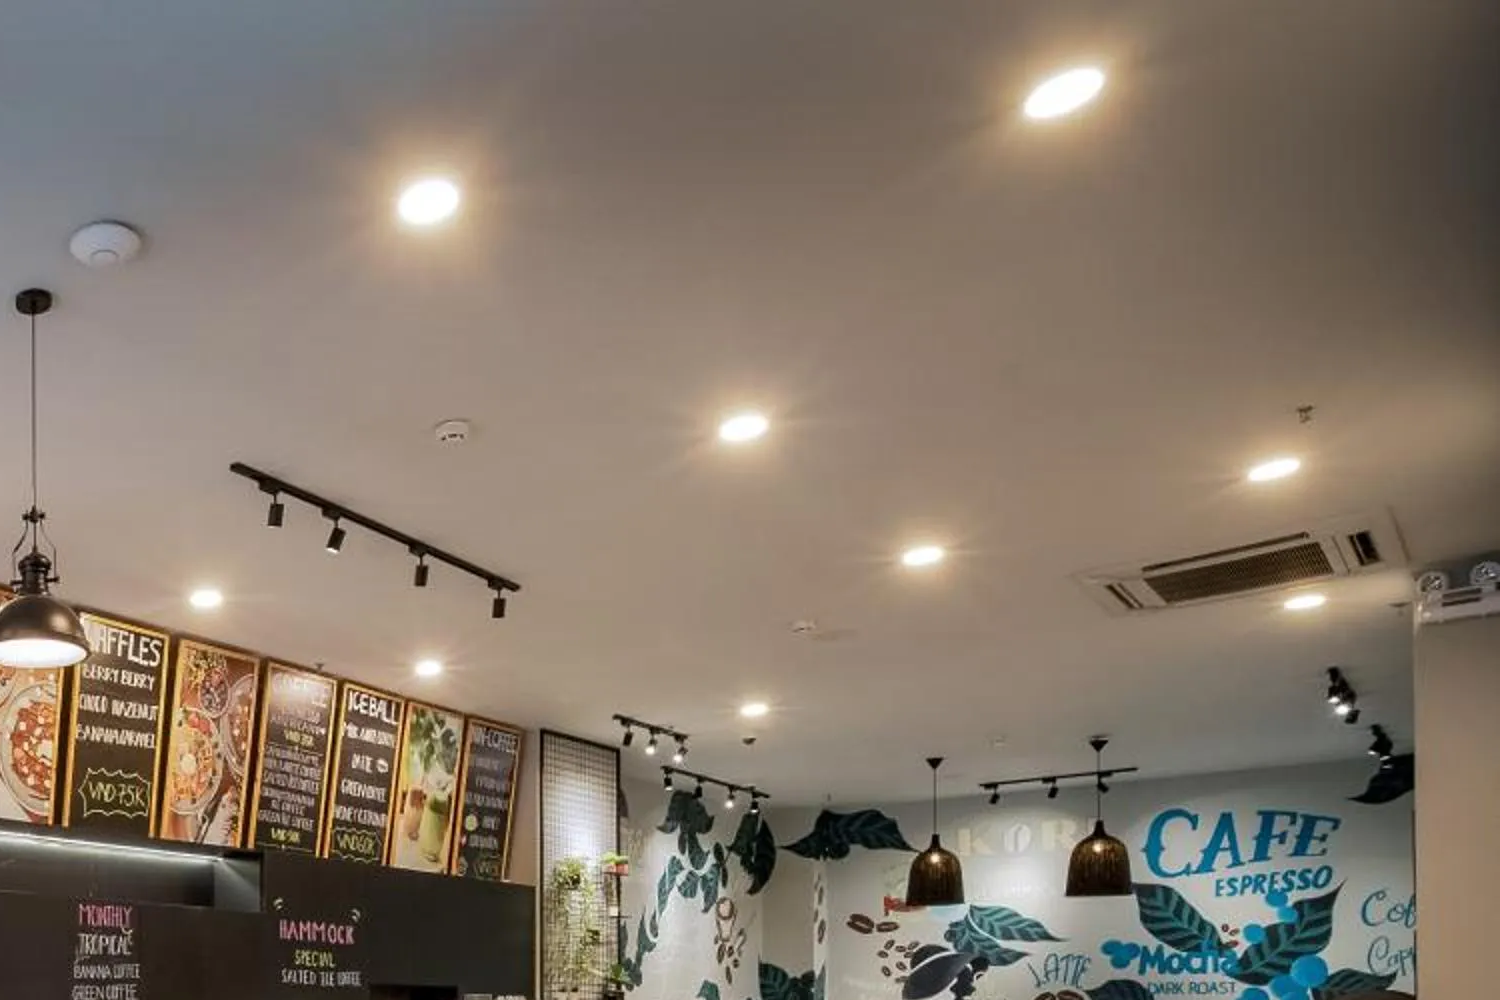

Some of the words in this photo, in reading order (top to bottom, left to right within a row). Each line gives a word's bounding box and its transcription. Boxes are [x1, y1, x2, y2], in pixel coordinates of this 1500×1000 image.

[1141, 808, 1342, 878] CAFE
[1215, 865, 1333, 898] ESPRESSO
[79, 904, 132, 928] MONTHLY
[280, 919, 355, 945] HAMMOCK
[295, 949, 336, 969] SPECIAL
[1148, 982, 1186, 996] DARK
[1188, 981, 1236, 996] ROAST
